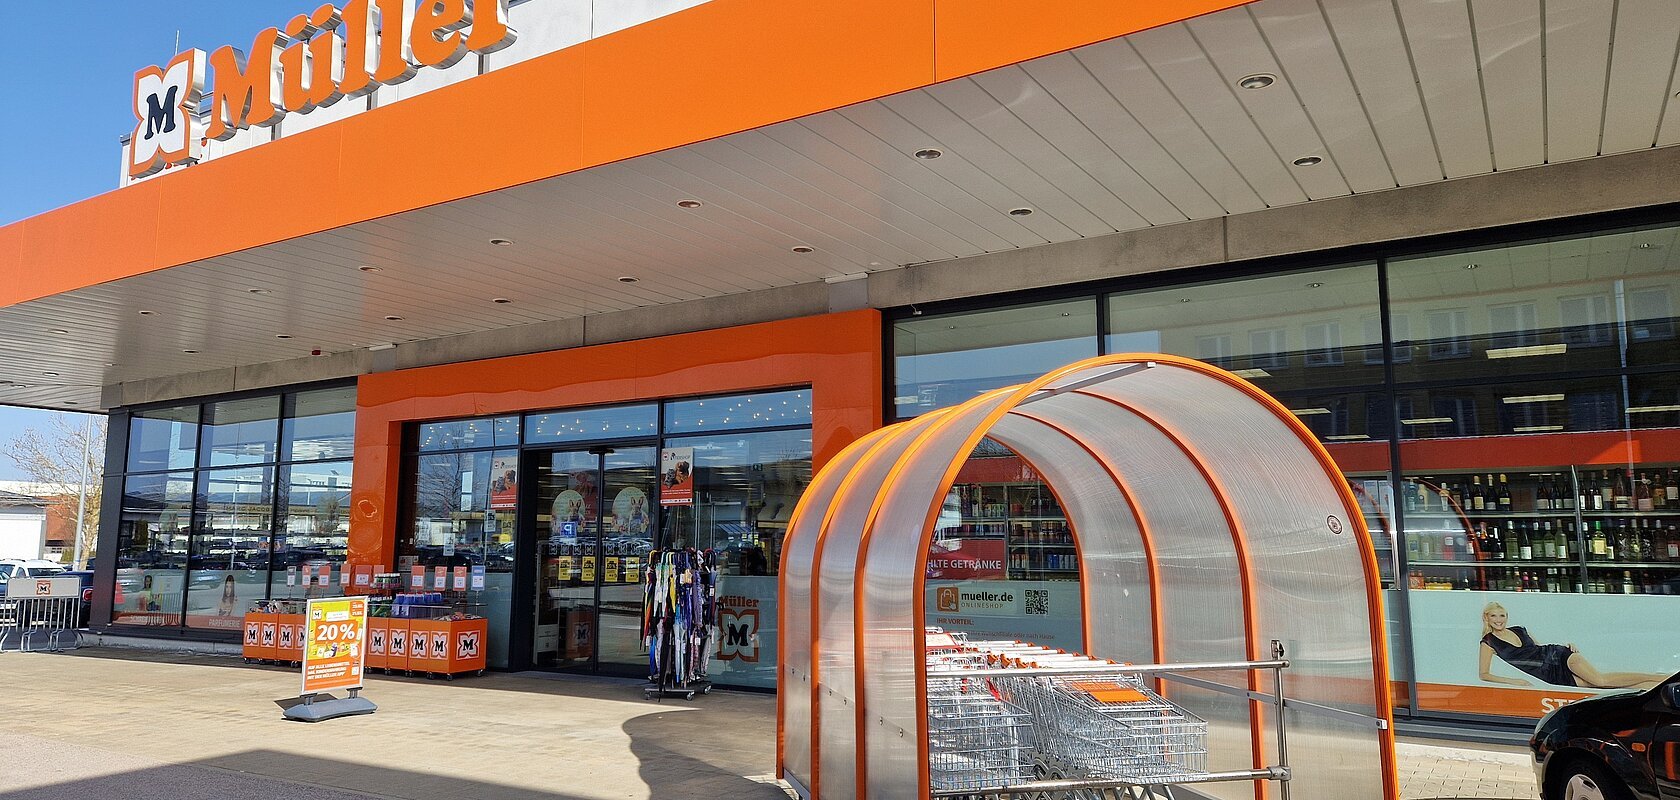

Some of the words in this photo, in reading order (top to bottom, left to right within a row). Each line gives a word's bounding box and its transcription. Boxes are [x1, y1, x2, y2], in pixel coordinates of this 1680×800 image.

[205, 0, 509, 141] Müller
[144, 85, 177, 141] M
[951, 558, 1002, 570] GETRÄNKE
[718, 595, 760, 608] Müller
[961, 591, 1014, 602] mueller.de
[949, 618, 975, 626] VORTEIL:
[248, 630, 256, 640] M
[264, 631, 272, 641] M
[282, 632, 290, 642] M
[317, 624, 338, 641] 20
[340, 622, 355, 640] %
[727, 624, 749, 647] M
[373, 636, 382, 647] M
[393, 638, 403, 649] M
[414, 639, 424, 650] M
[434, 640, 444, 652] M
[462, 639, 474, 651] M
